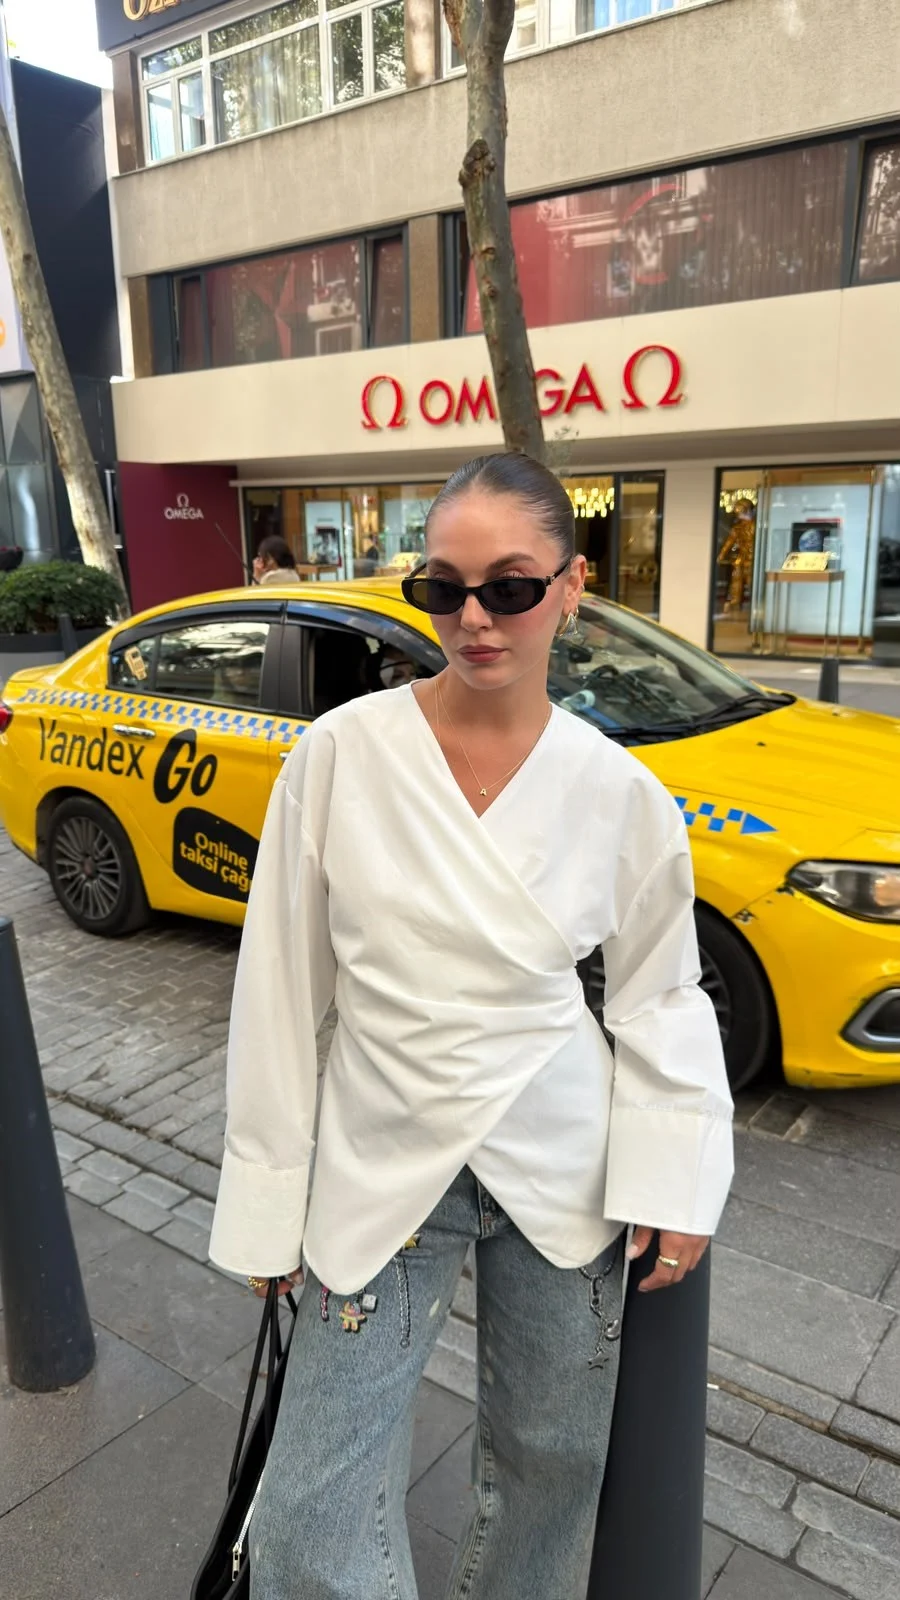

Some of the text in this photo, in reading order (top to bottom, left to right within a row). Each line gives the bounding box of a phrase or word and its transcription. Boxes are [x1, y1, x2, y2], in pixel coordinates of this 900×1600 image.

[419, 362, 605, 426] OMGA
[164, 507, 204, 520] OMEGA
[39, 717, 218, 804] Yandex Go
[180, 841, 253, 893] taksi çağ
[194, 832, 249, 870] Online
